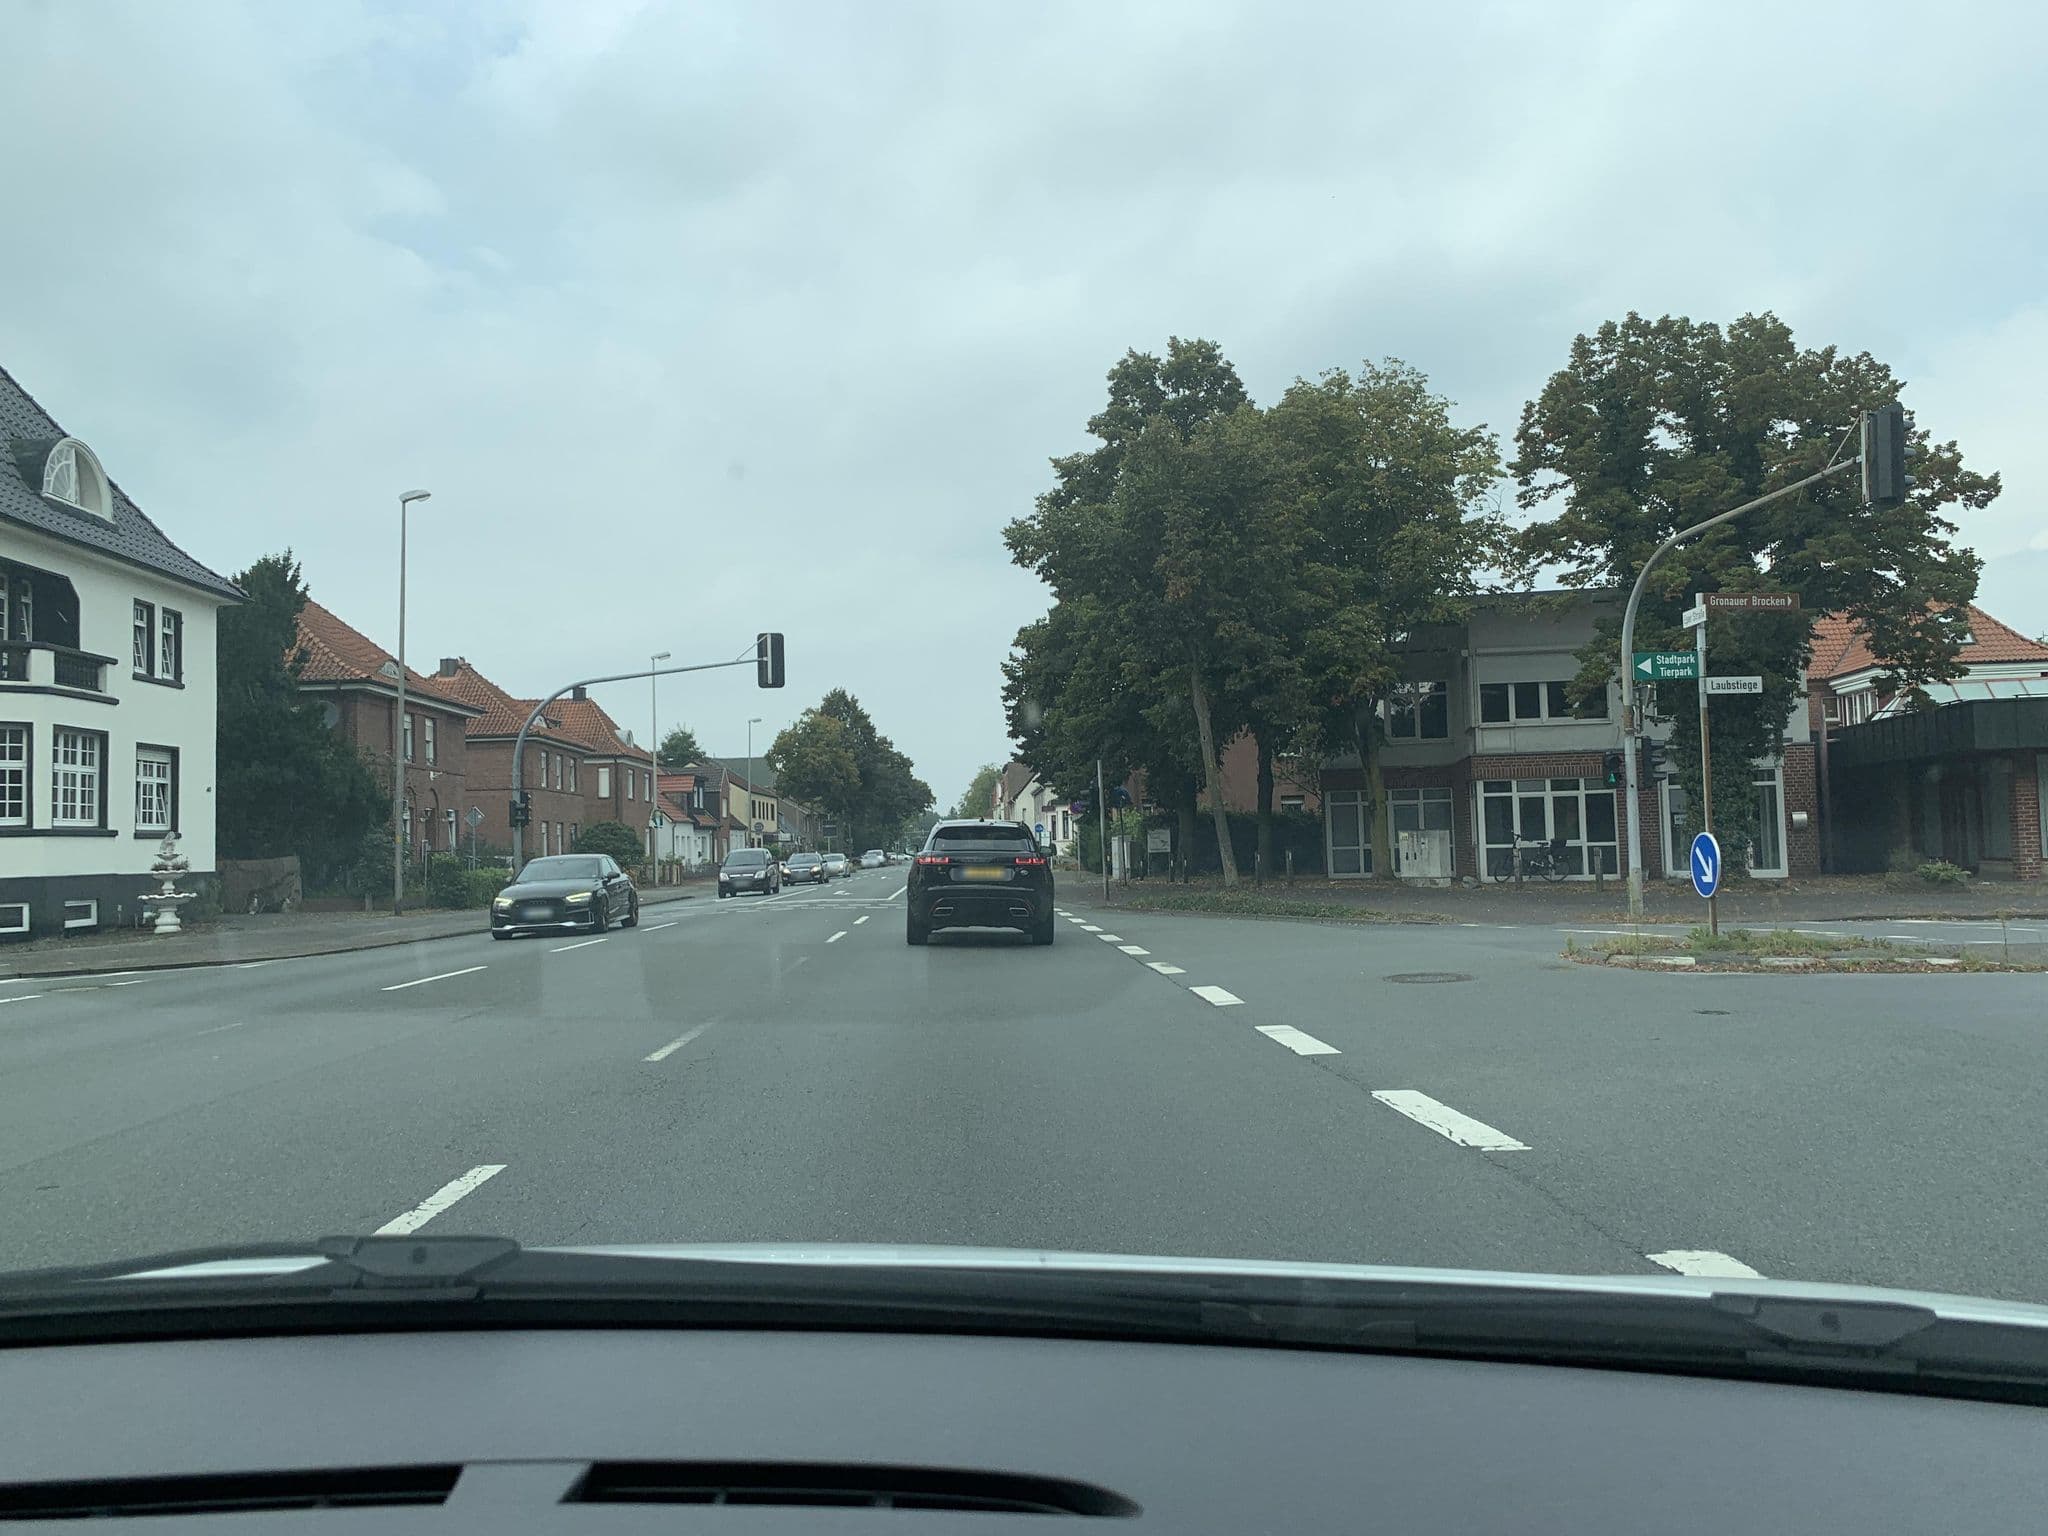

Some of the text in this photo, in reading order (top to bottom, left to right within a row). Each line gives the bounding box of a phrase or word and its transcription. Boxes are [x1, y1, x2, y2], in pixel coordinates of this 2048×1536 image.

[1710, 596, 1786, 606] Gronauer Brocken
[1656, 655, 1696, 665] Stadtpark
[1659, 667, 1693, 678] Tierpark
[1711, 680, 1758, 692] Laubstiege
